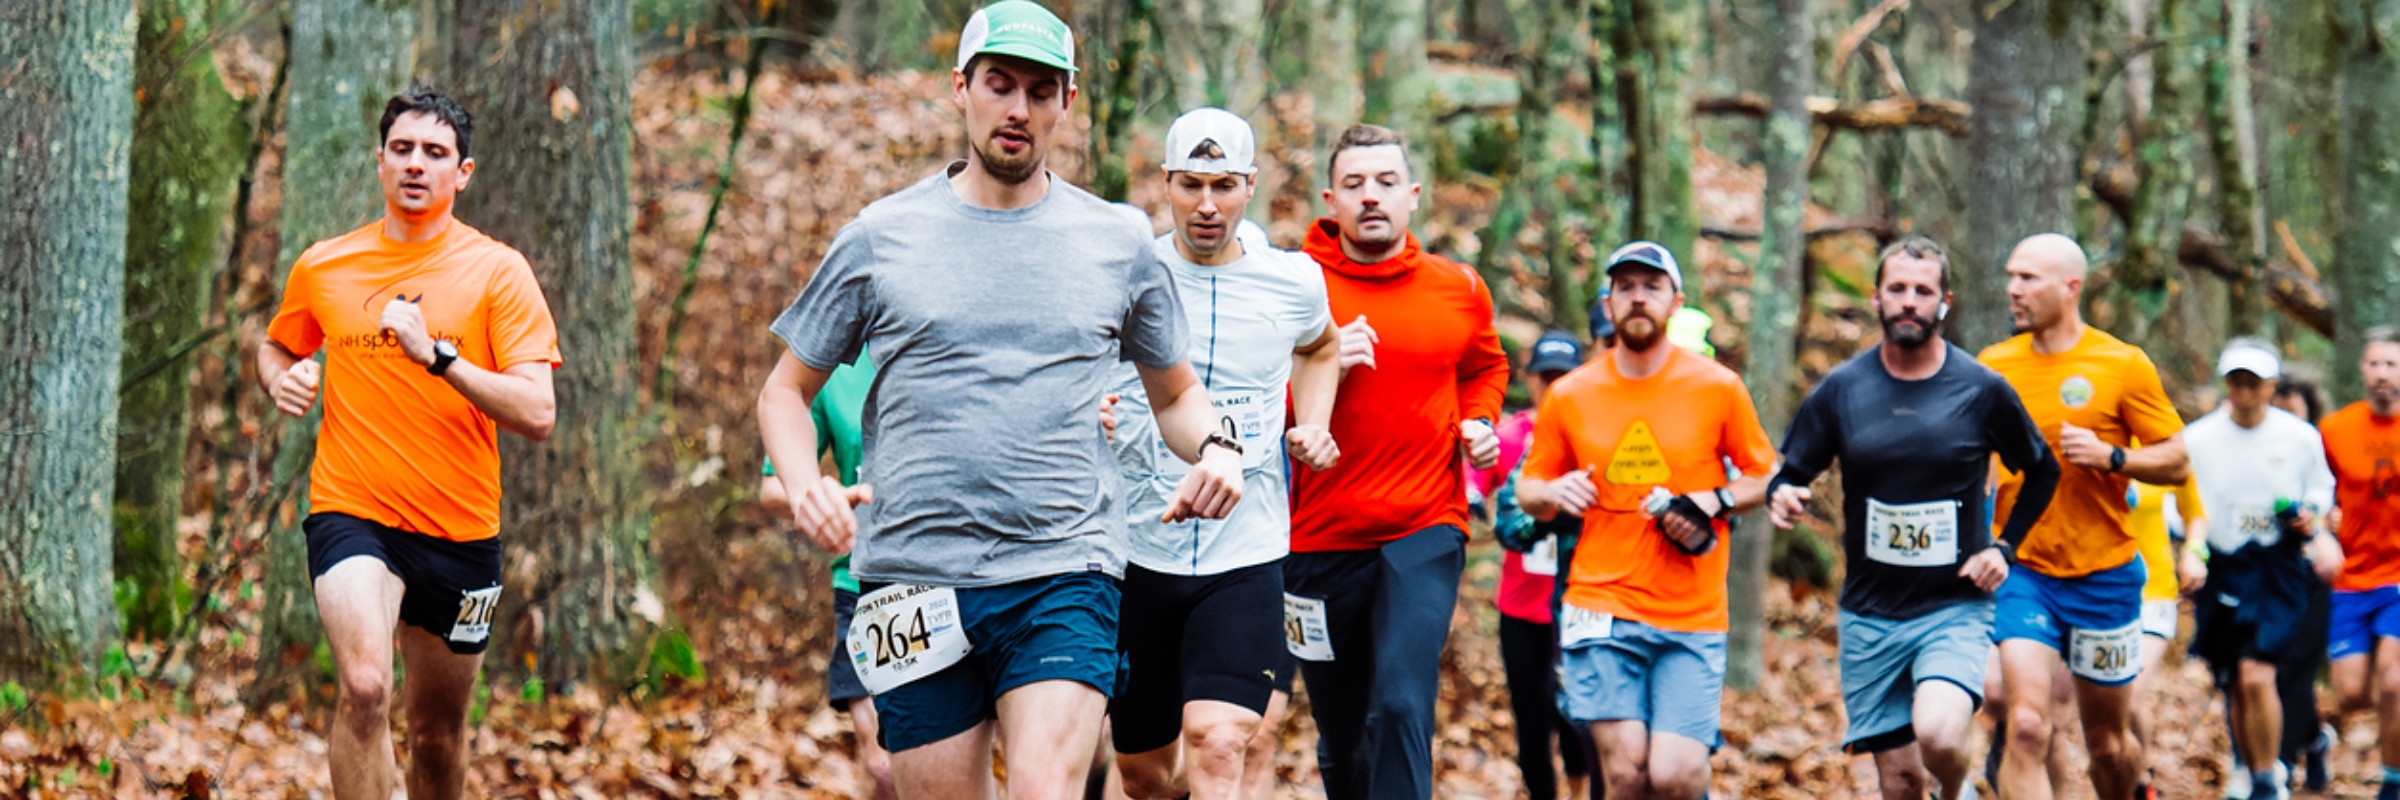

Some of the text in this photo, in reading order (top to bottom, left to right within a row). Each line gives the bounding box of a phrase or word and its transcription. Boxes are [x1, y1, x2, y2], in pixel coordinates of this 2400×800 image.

[340, 336, 359, 348] NH
[1889, 522, 1932, 551] 236
[873, 592, 905, 608] TRAIL
[867, 606, 932, 669] 264
[2093, 644, 2127, 671] 201
